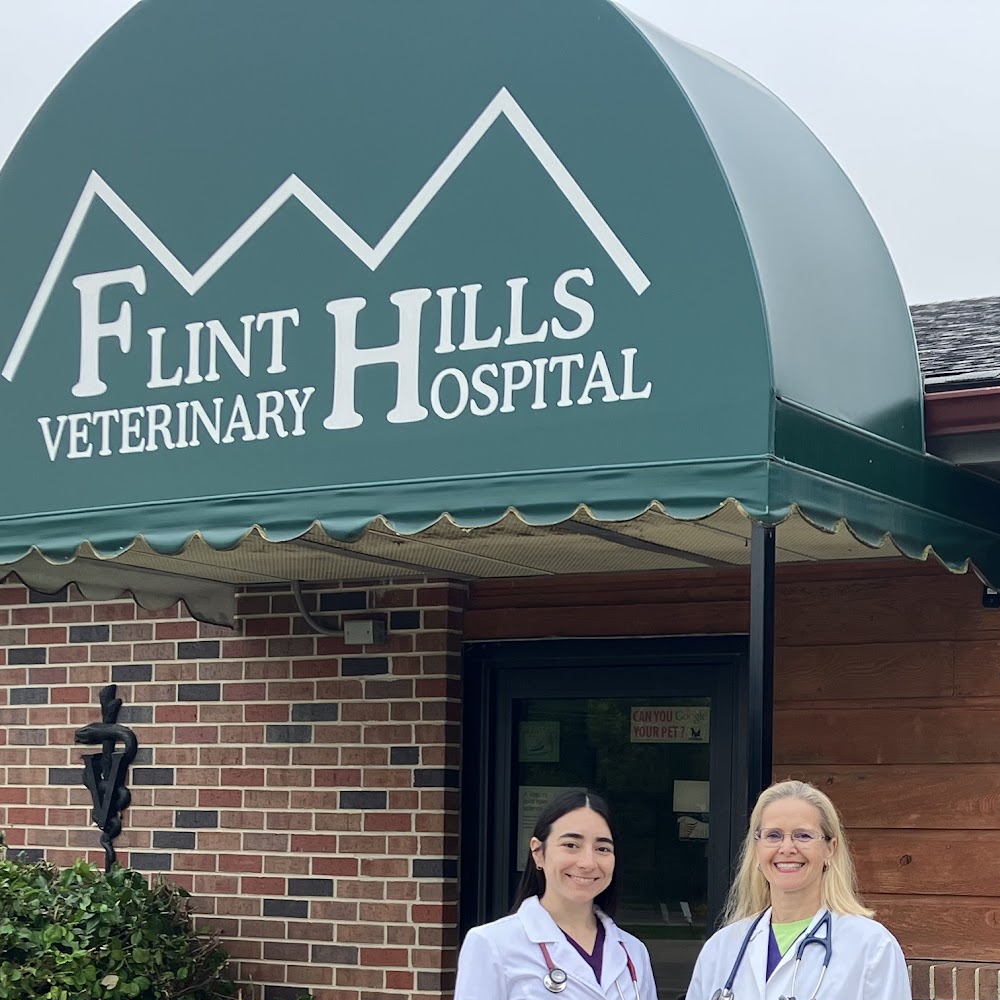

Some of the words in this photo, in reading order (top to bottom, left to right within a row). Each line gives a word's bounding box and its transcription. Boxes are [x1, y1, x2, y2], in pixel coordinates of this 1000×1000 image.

[71, 264, 300, 398] FLINT
[322, 267, 595, 430] HILLS
[37, 386, 316, 462] VETERINARY
[633, 710, 652, 723] CAN
[653, 710, 673, 723] YOU
[633, 725, 659, 738] YOUR
[661, 726, 679, 738] PET
